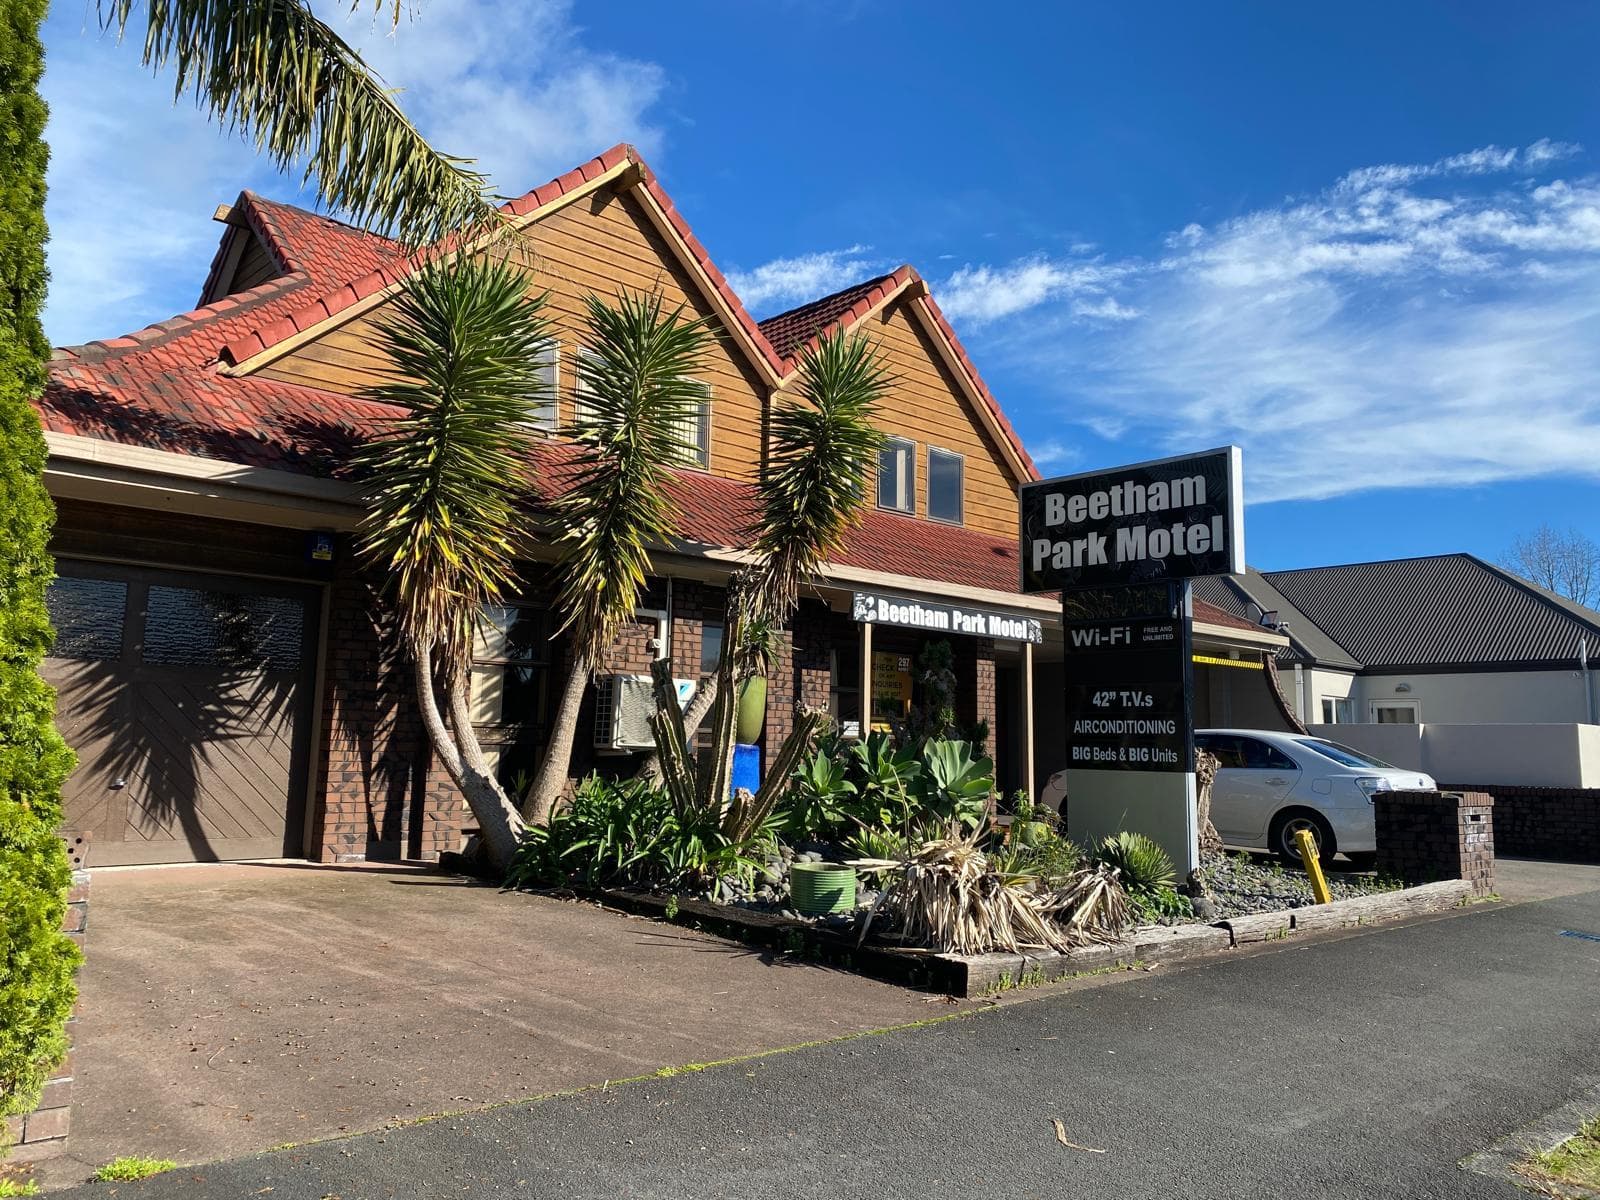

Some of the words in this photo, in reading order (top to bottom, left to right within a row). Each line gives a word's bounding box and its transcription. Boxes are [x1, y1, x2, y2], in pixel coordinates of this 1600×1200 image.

[1045, 474, 1207, 527] Beetham
[1032, 530, 1108, 572] Park
[1116, 515, 1224, 563] Motel
[877, 599, 949, 629] Beetham
[952, 610, 986, 634] Park
[989, 616, 1027, 639] Motel
[1071, 627, 1131, 647] Wi-Fi
[1143, 634, 1174, 642] UNLIMITED
[1120, 691, 1153, 707] T.V.s
[1073, 719, 1176, 735] AIRCONDITIONING
[1072, 746, 1091, 760] BIG
[1093, 747, 1117, 761] Beds
[1119, 748, 1127, 761] &
[1129, 748, 1149, 762] BIG
[1151, 748, 1178, 763] Units
